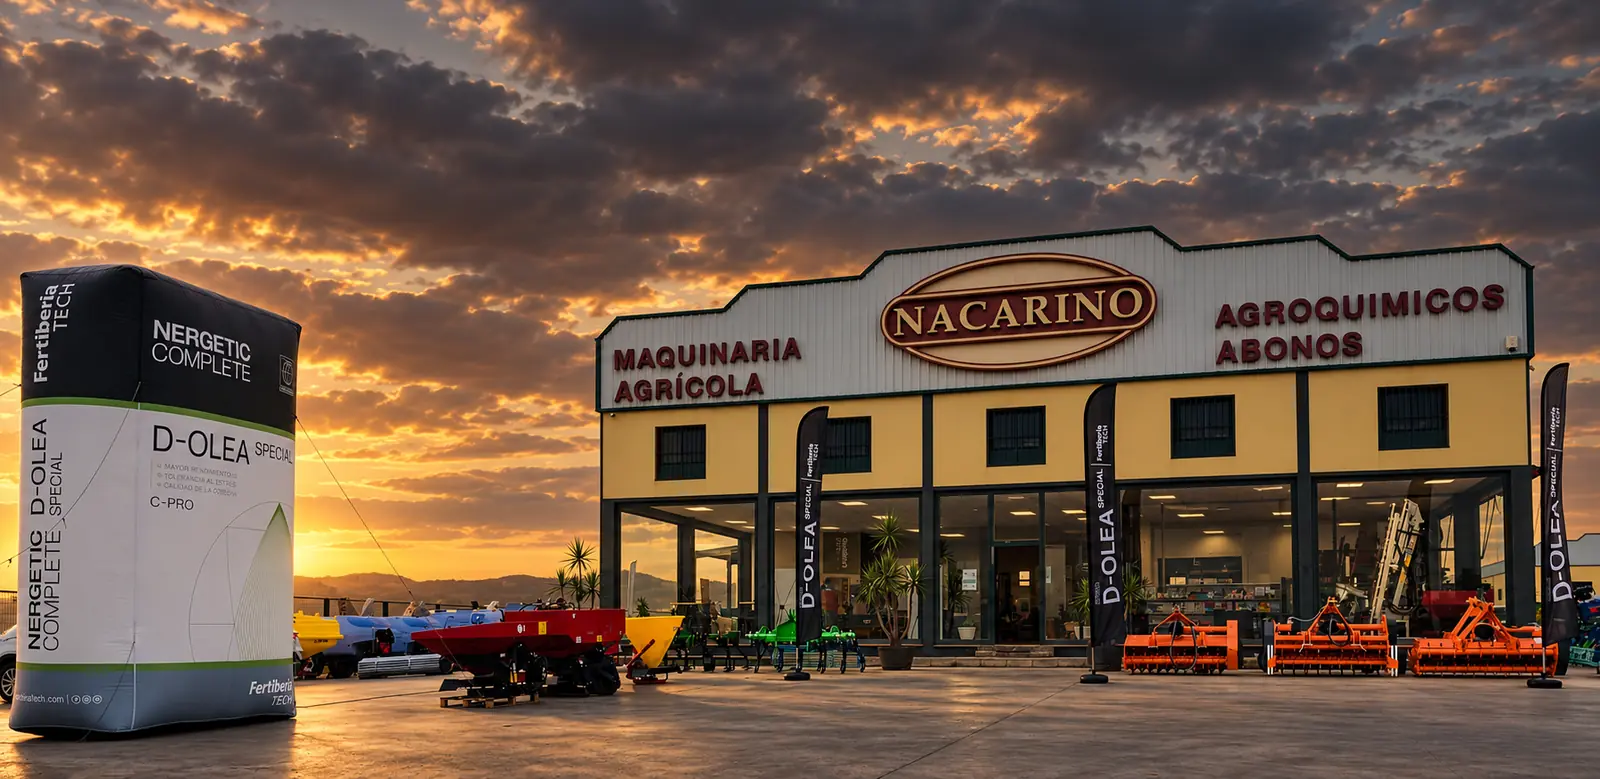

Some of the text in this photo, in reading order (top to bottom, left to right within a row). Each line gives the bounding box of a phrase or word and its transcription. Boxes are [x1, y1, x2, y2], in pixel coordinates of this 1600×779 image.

[53, 283, 75, 332] TECH
[893, 287, 1143, 336] NACARINO
[1215, 283, 1505, 329] AGROQUIMICOS
[34, 285, 59, 383] Fertiberia
[153, 319, 251, 362] NERGETIC
[613, 337, 802, 371] MAQUINARIA
[1216, 331, 1363, 365] ABONOS
[152, 342, 251, 382] COMPLETE
[614, 372, 764, 403] AGRÍCOLA
[153, 425, 293, 465] D-OLEA SPECIAL
[150, 495, 194, 511] C-PRO
[28, 418, 47, 650] NERGETIC D-OLEA
[43, 452, 63, 652] COMPLETE SPECIAL
[1096, 468, 1121, 605] D-OLEA SPECIAL
[1549, 500, 1573, 603] D-OLEA
[801, 521, 817, 609] D-OLEA
[271, 694, 293, 706] TECH
